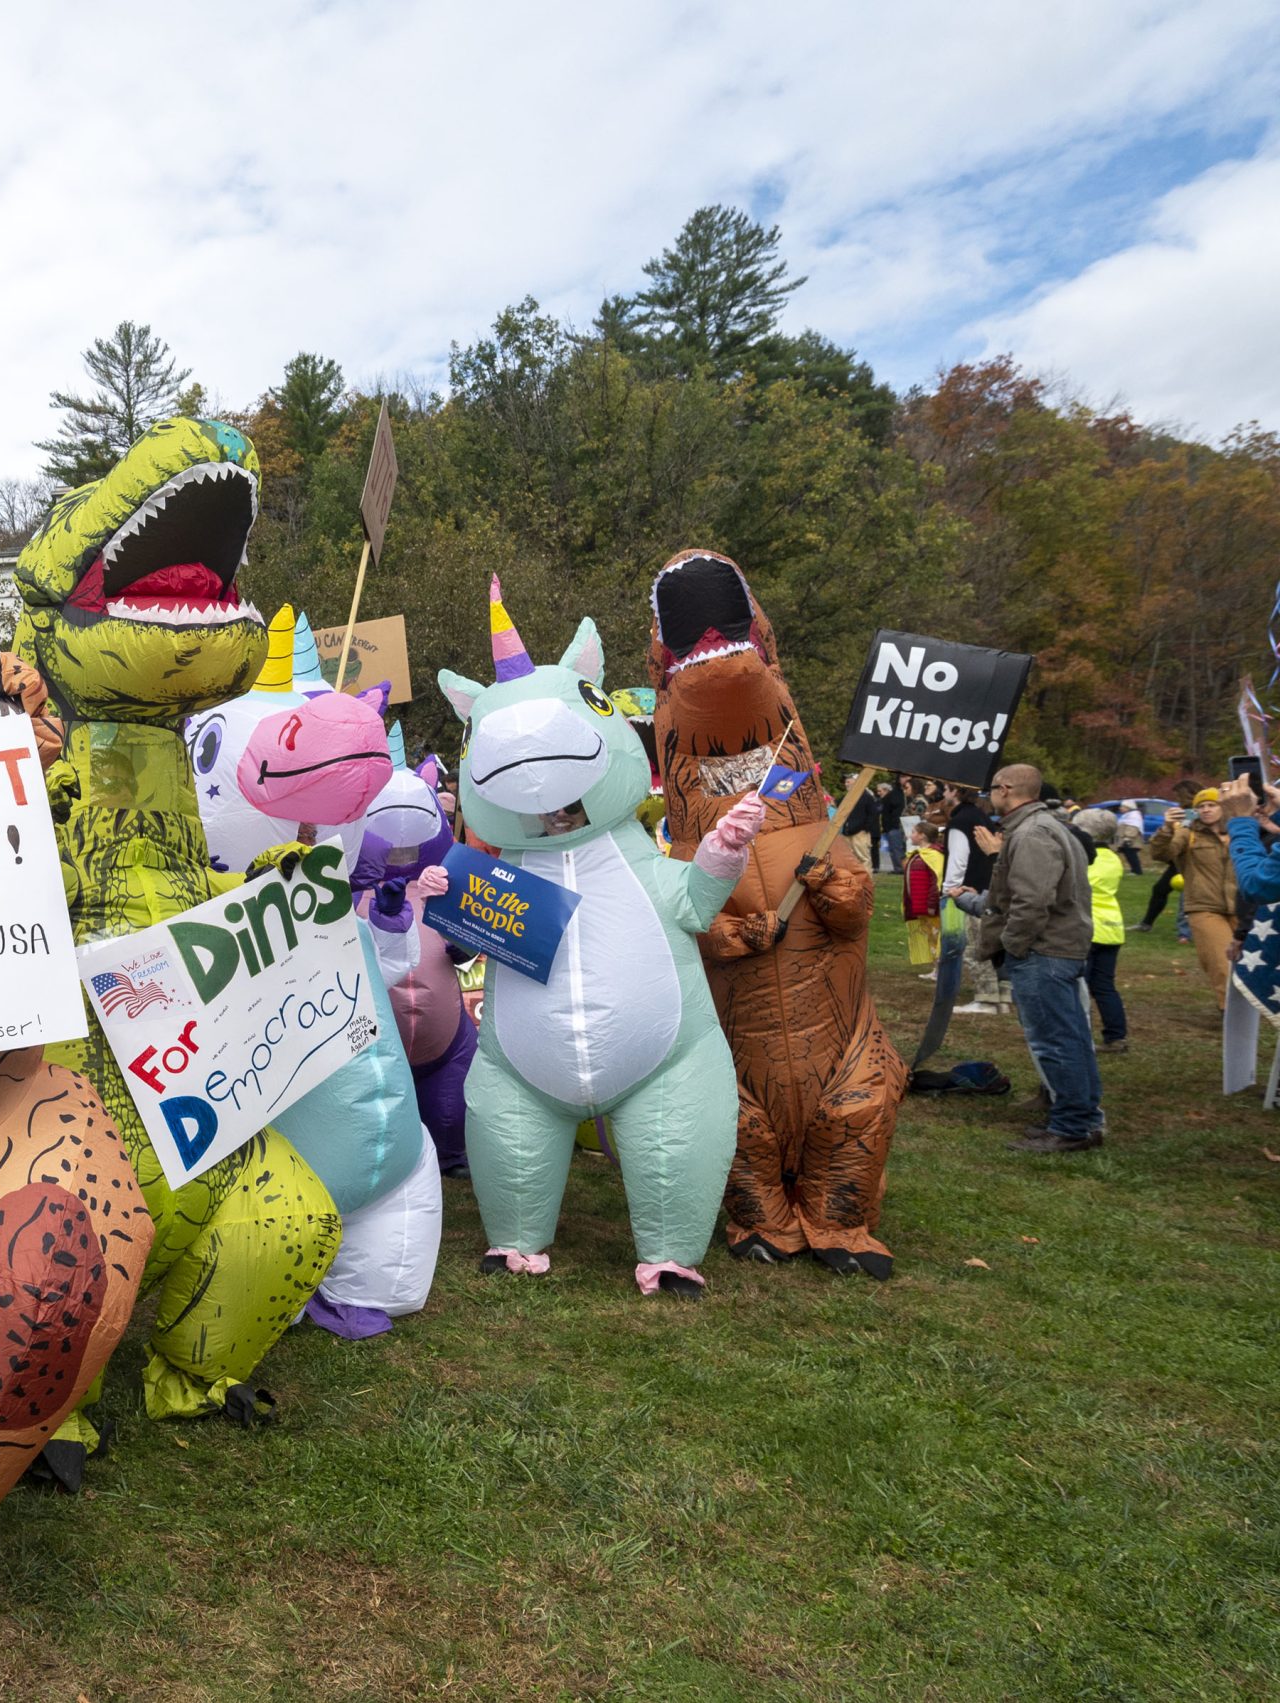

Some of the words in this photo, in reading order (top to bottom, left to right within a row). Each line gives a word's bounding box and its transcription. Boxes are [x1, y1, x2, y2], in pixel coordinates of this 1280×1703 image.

[351, 635, 379, 653] REVENT
[871, 642, 959, 692] No
[859, 695, 1008, 753] Kings!
[468, 873, 497, 903] We
[496, 892, 530, 916] the
[491, 867, 516, 883] ACLU
[167, 844, 354, 1006] Dinos
[459, 892, 525, 937] People
[130, 960, 170, 982] FREEDOM
[346, 1019, 373, 1041] America
[128, 1020, 200, 1094] For
[158, 971, 361, 1173] Democracy
